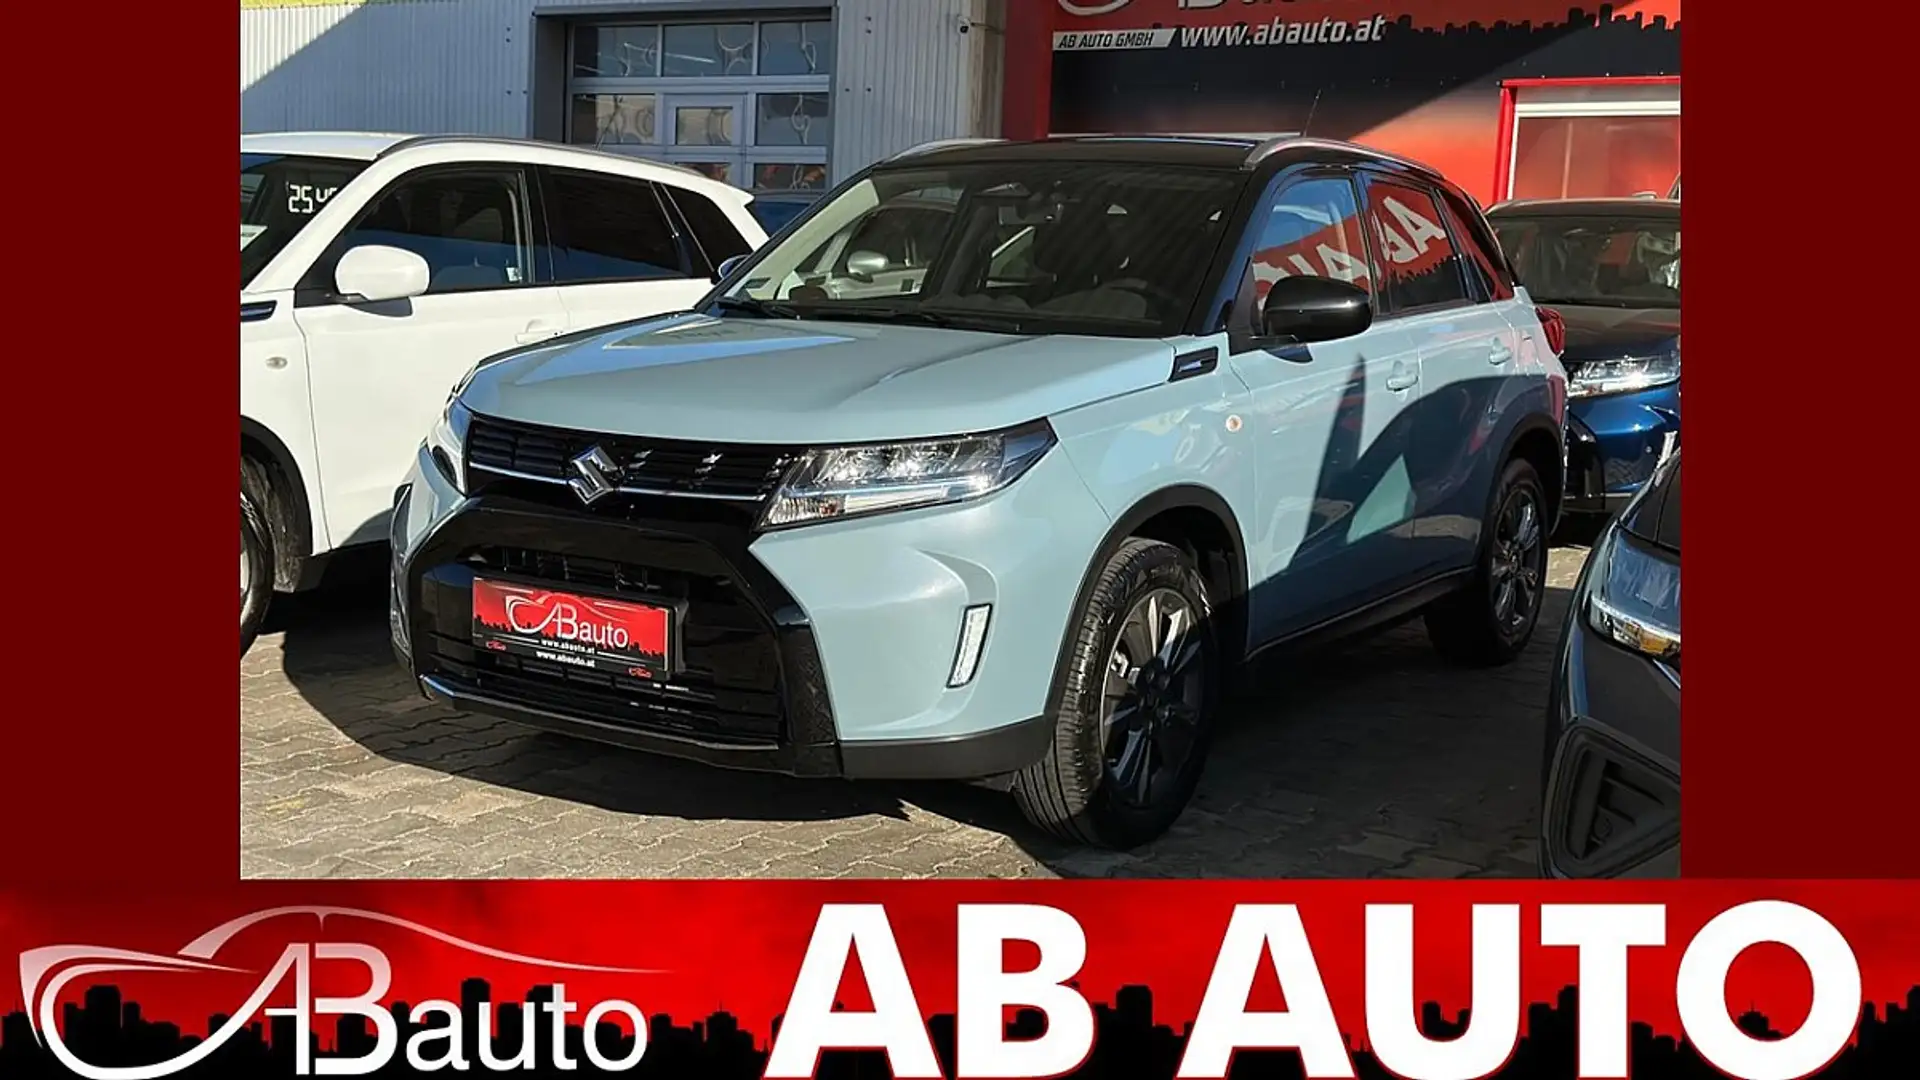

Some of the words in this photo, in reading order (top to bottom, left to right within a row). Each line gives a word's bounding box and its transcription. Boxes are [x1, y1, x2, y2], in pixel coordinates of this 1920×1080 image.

[1058, 35, 1076, 48] AB
[1078, 33, 1112, 48] AUTO
[1115, 31, 1154, 47] GMBH
[1180, 14, 1387, 48] www.abauto.at
[510, 600, 629, 648] ABauto
